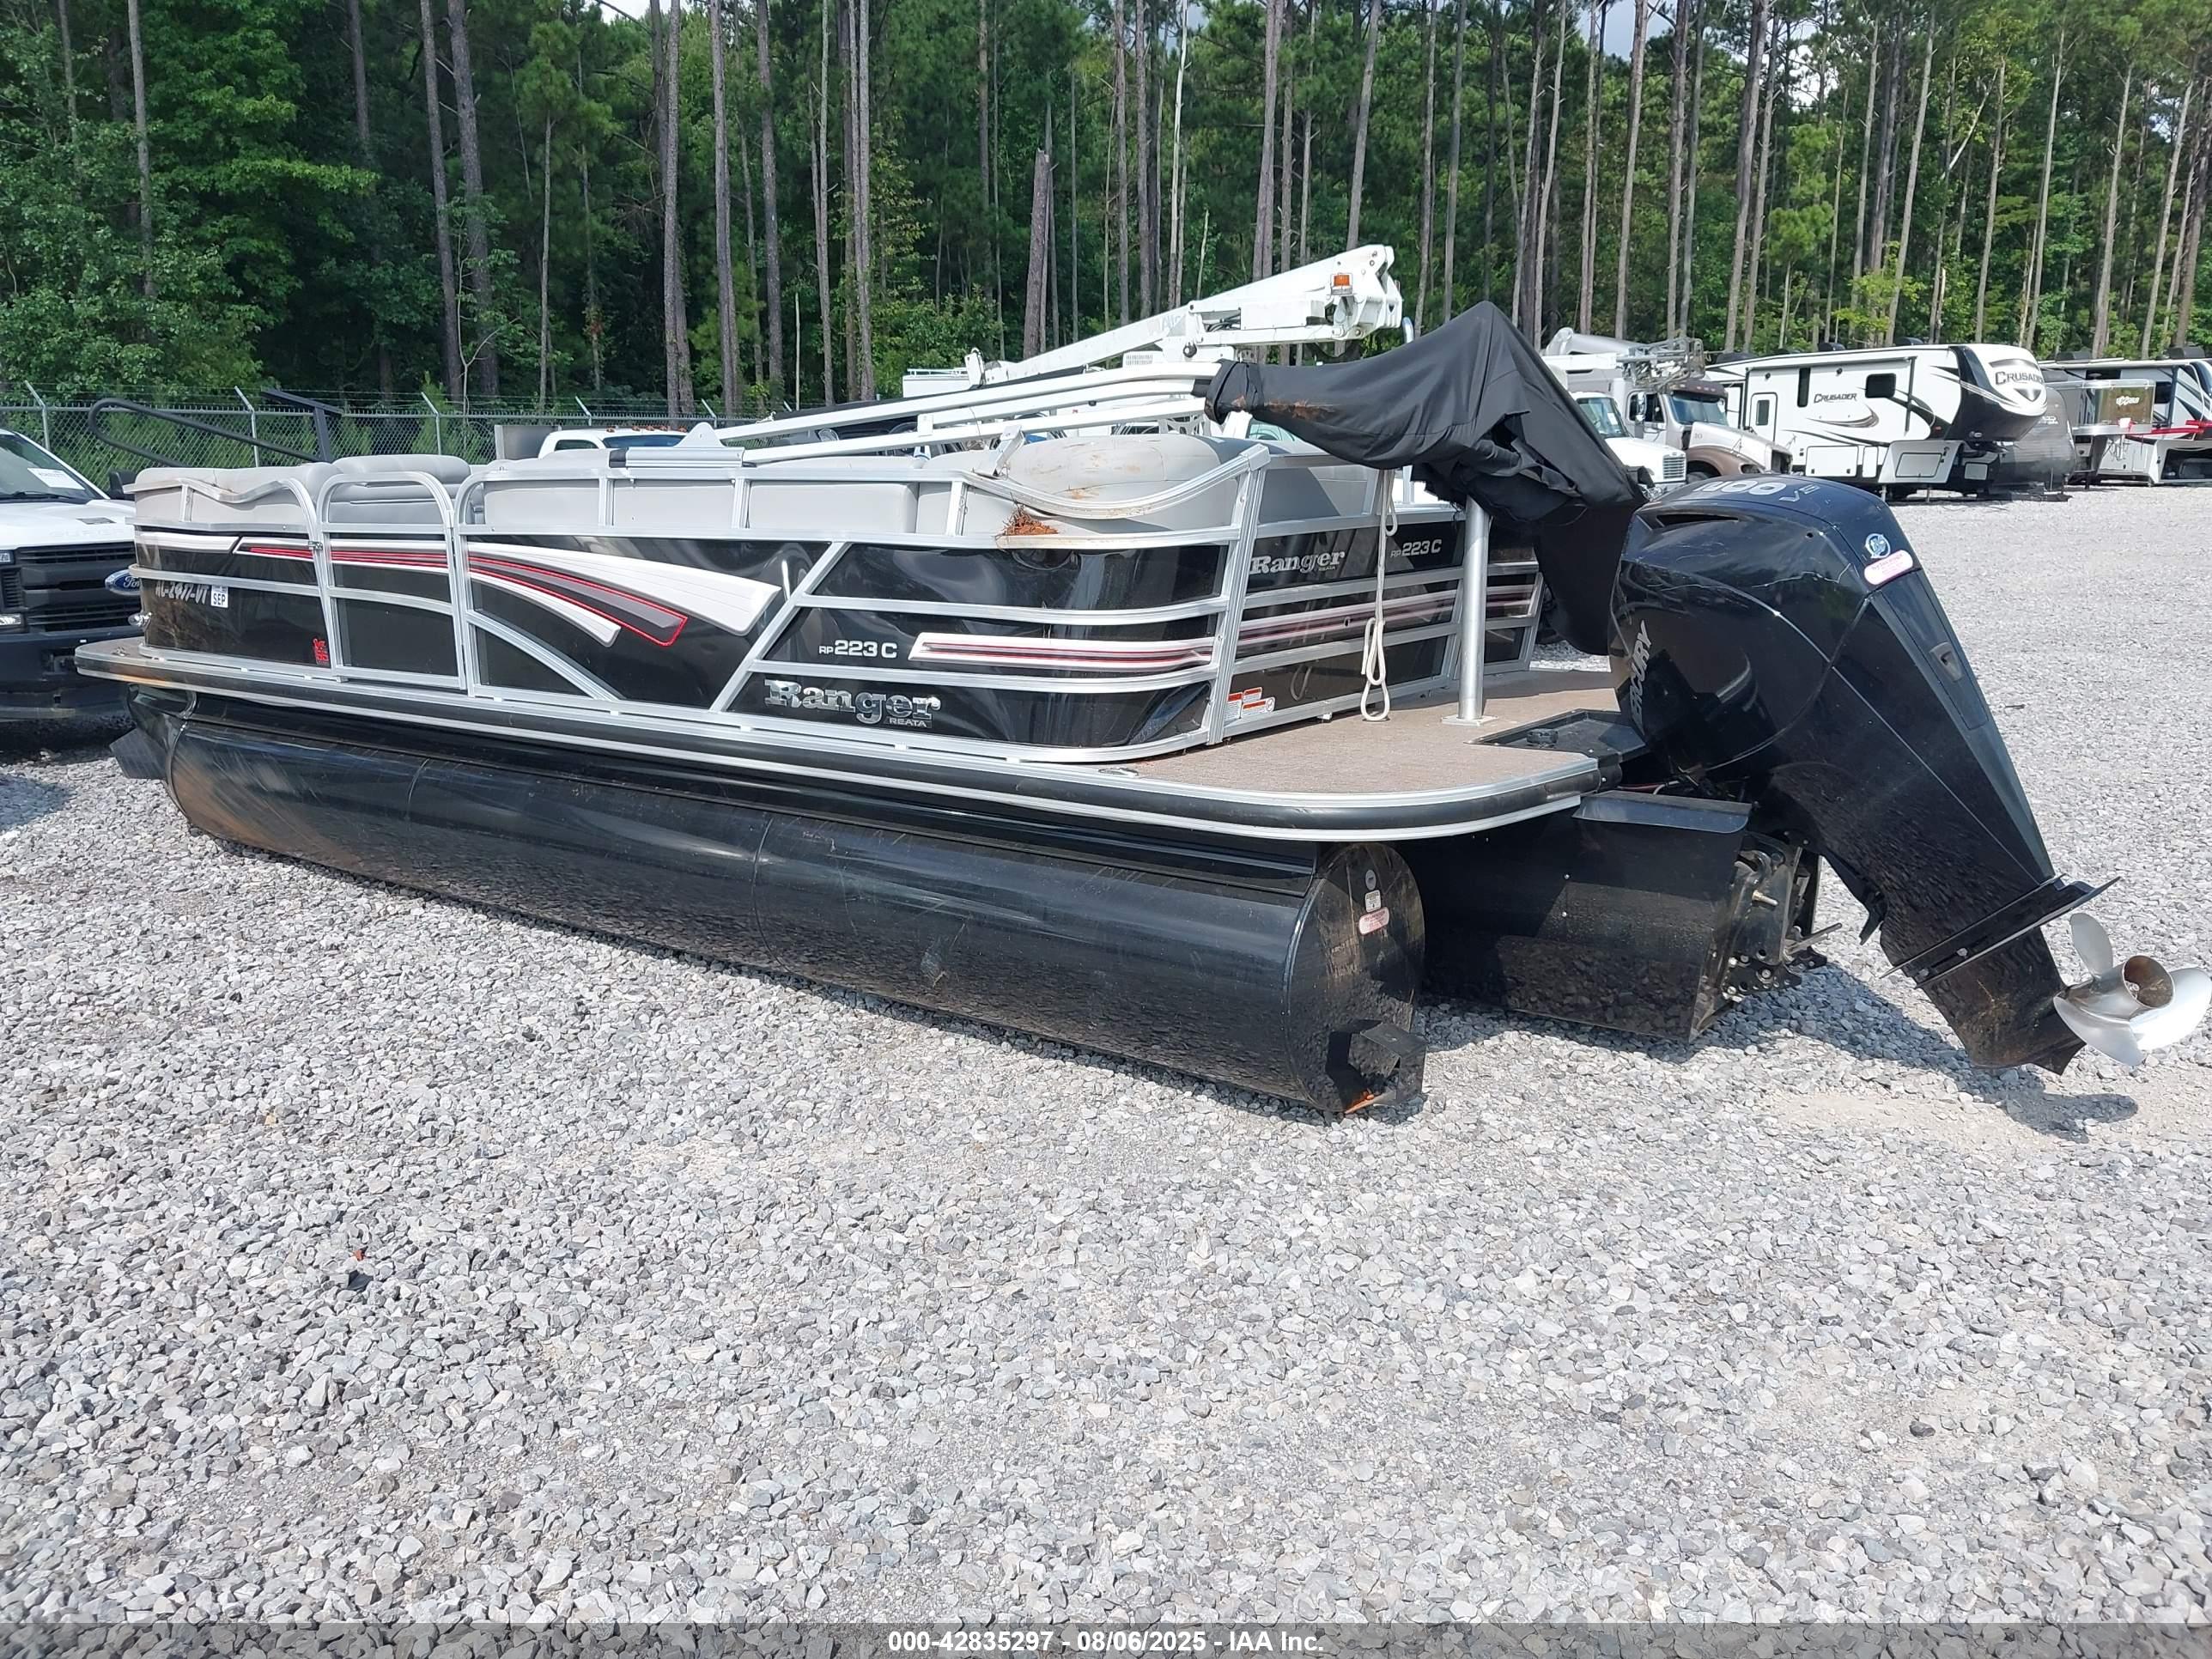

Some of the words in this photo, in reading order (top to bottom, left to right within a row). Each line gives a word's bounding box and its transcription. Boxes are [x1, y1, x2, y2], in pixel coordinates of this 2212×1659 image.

[1249, 551, 1346, 574] Ranger
[213, 593, 226, 605] SEP
[1630, 619, 1651, 736] ERCURY
[763, 679, 941, 725] Ranger
[889, 717, 927, 728] REATA
